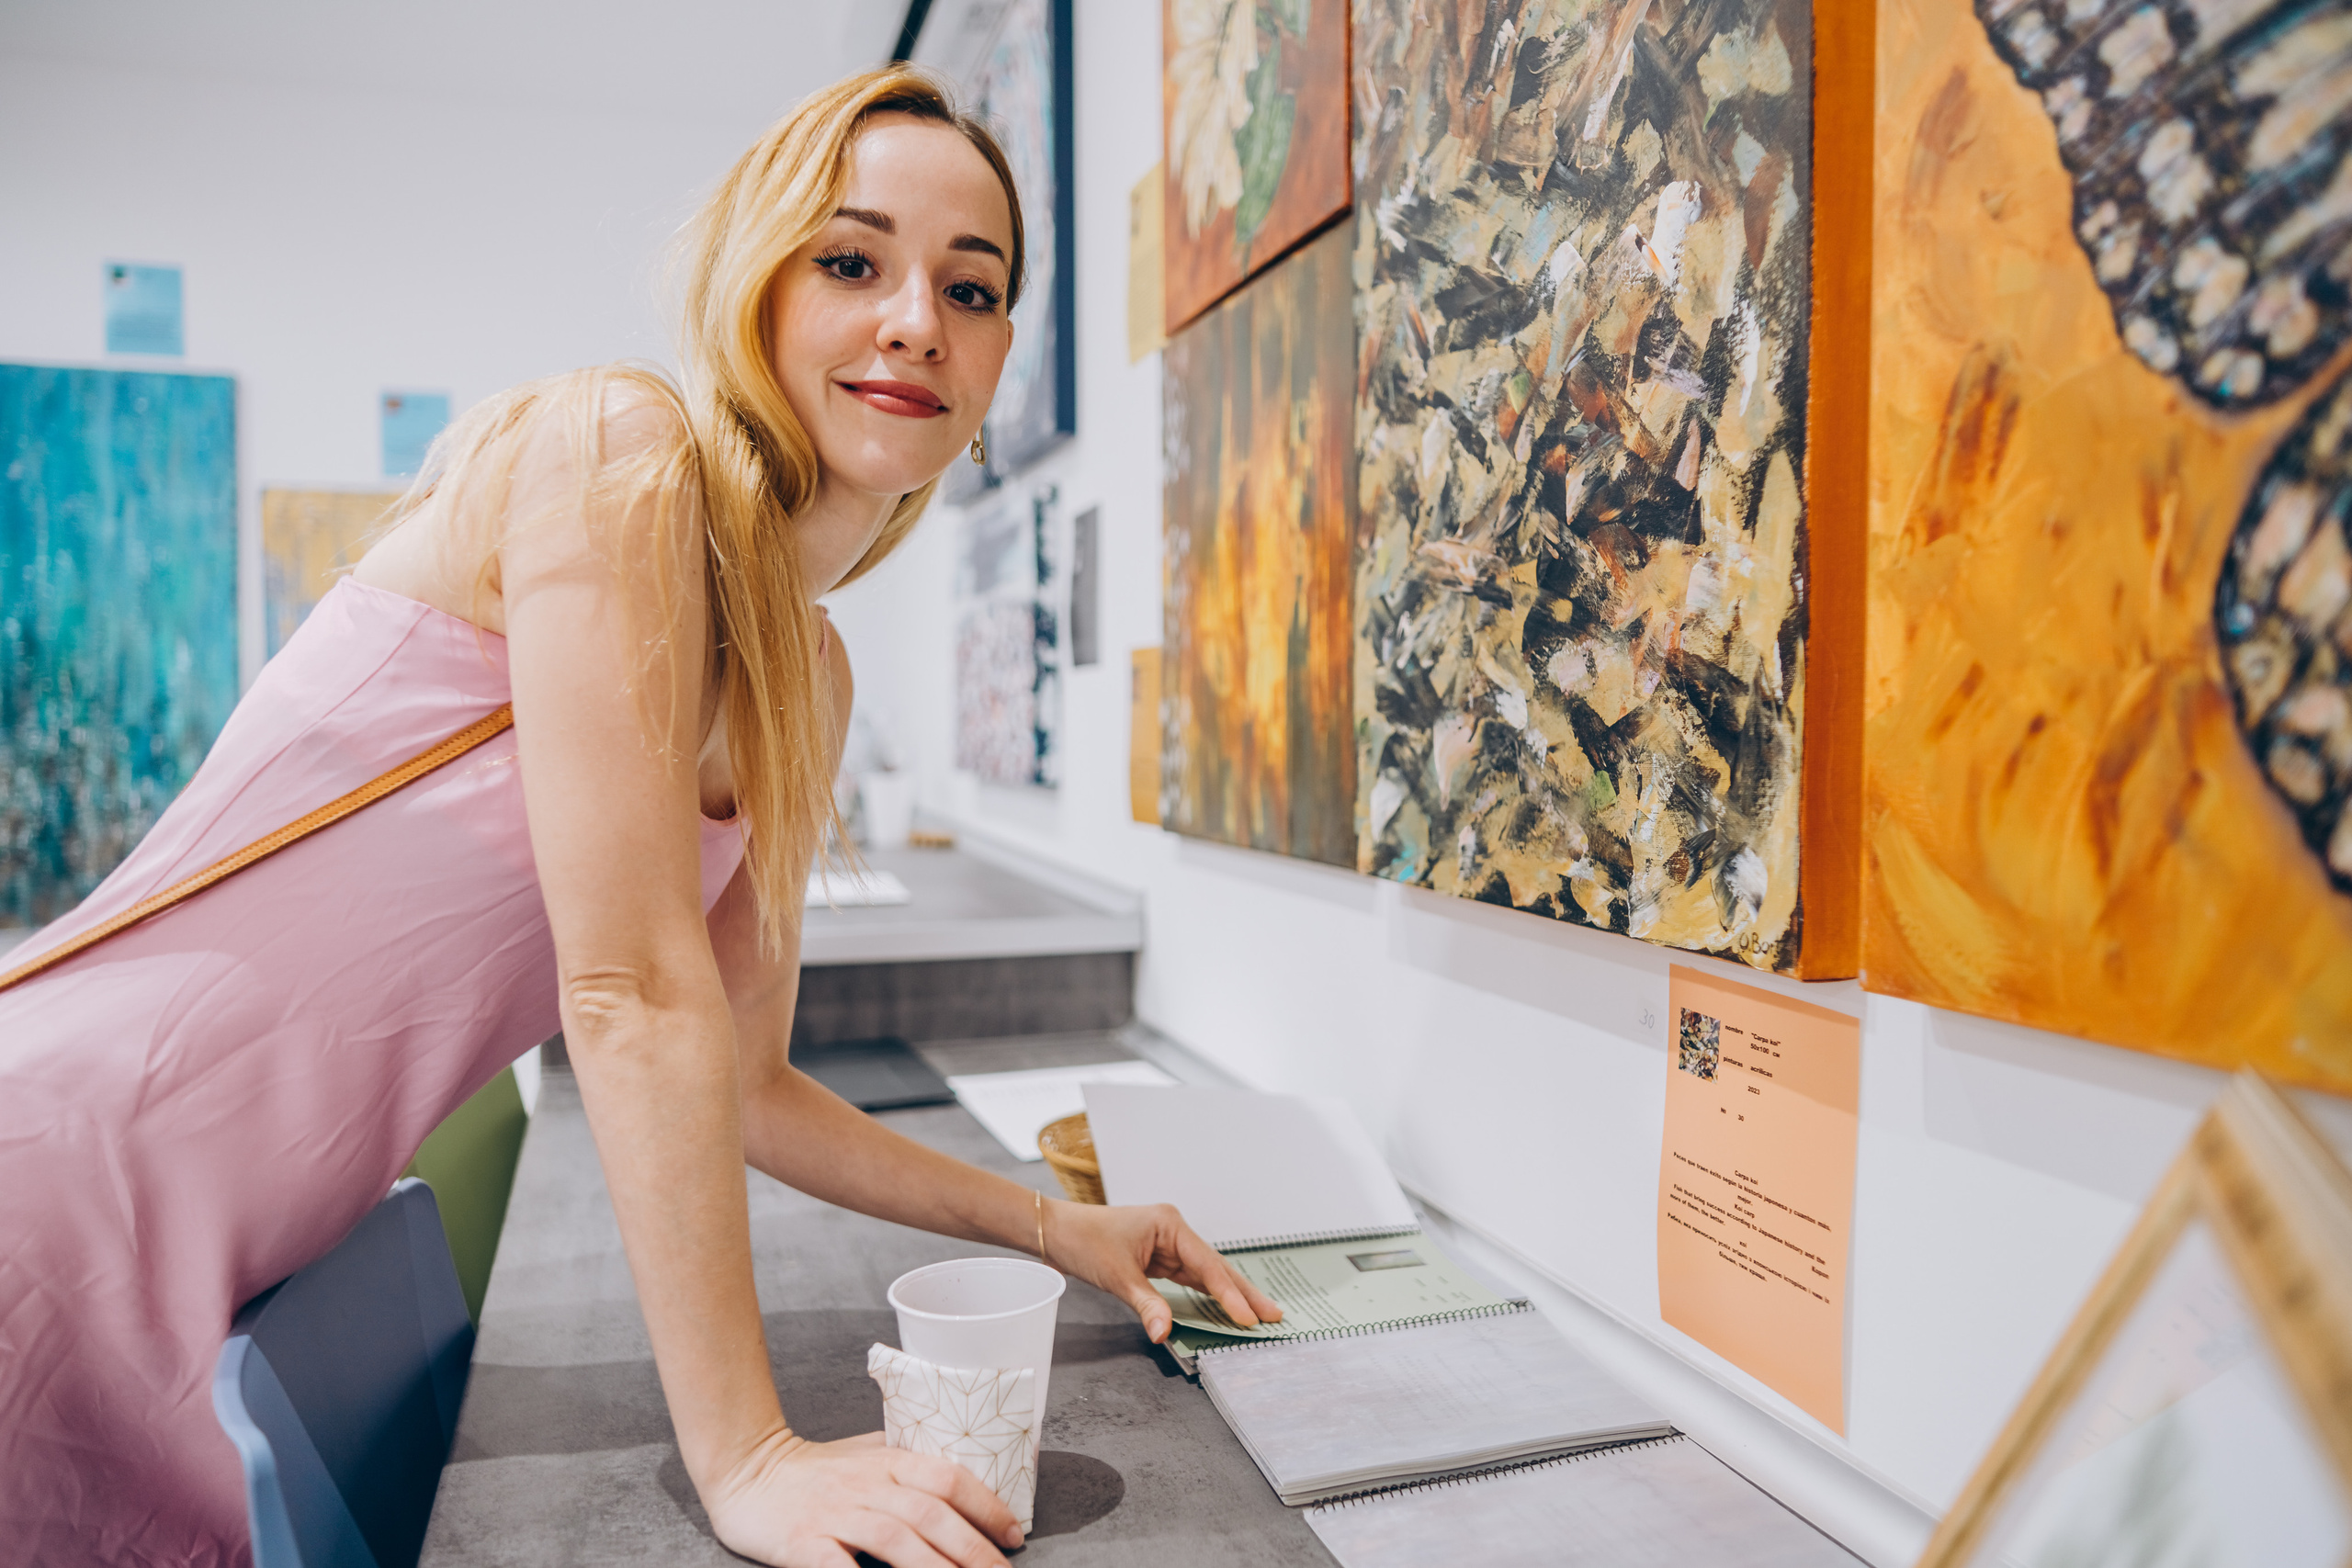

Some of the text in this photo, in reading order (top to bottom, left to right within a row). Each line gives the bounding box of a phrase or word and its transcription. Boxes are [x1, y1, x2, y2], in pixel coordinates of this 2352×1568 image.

[1639, 1009, 1655, 1030] 30
[1724, 1025, 1744, 1035] nombre
[1750, 1032, 1769, 1043] "Carpa
[1750, 1043, 1770, 1055] 50x100
[1723, 1056, 1744, 1068] pinturas
[1747, 1086, 1761, 1096] 2023
[1737, 1113, 1745, 1122] 30
[1674, 1152, 1686, 1162] Peces
[1744, 1186, 1762, 1199] historia
[1764, 1195, 1787, 1211] japonesa
[1735, 1170, 1748, 1182] Carpa
[1670, 1194, 1680, 1202] more
[1710, 1213, 1725, 1225] better.
[1744, 1209, 1755, 1218] carp
[1684, 1189, 1692, 1198] that
[1694, 1194, 1705, 1205] bring
[1707, 1201, 1725, 1214] success
[1727, 1213, 1750, 1229] according
[1758, 1228, 1783, 1244] Japanese
[1784, 1241, 1803, 1255] history
[1805, 1250, 1815, 1259] and
[1816, 1257, 1826, 1265] the
